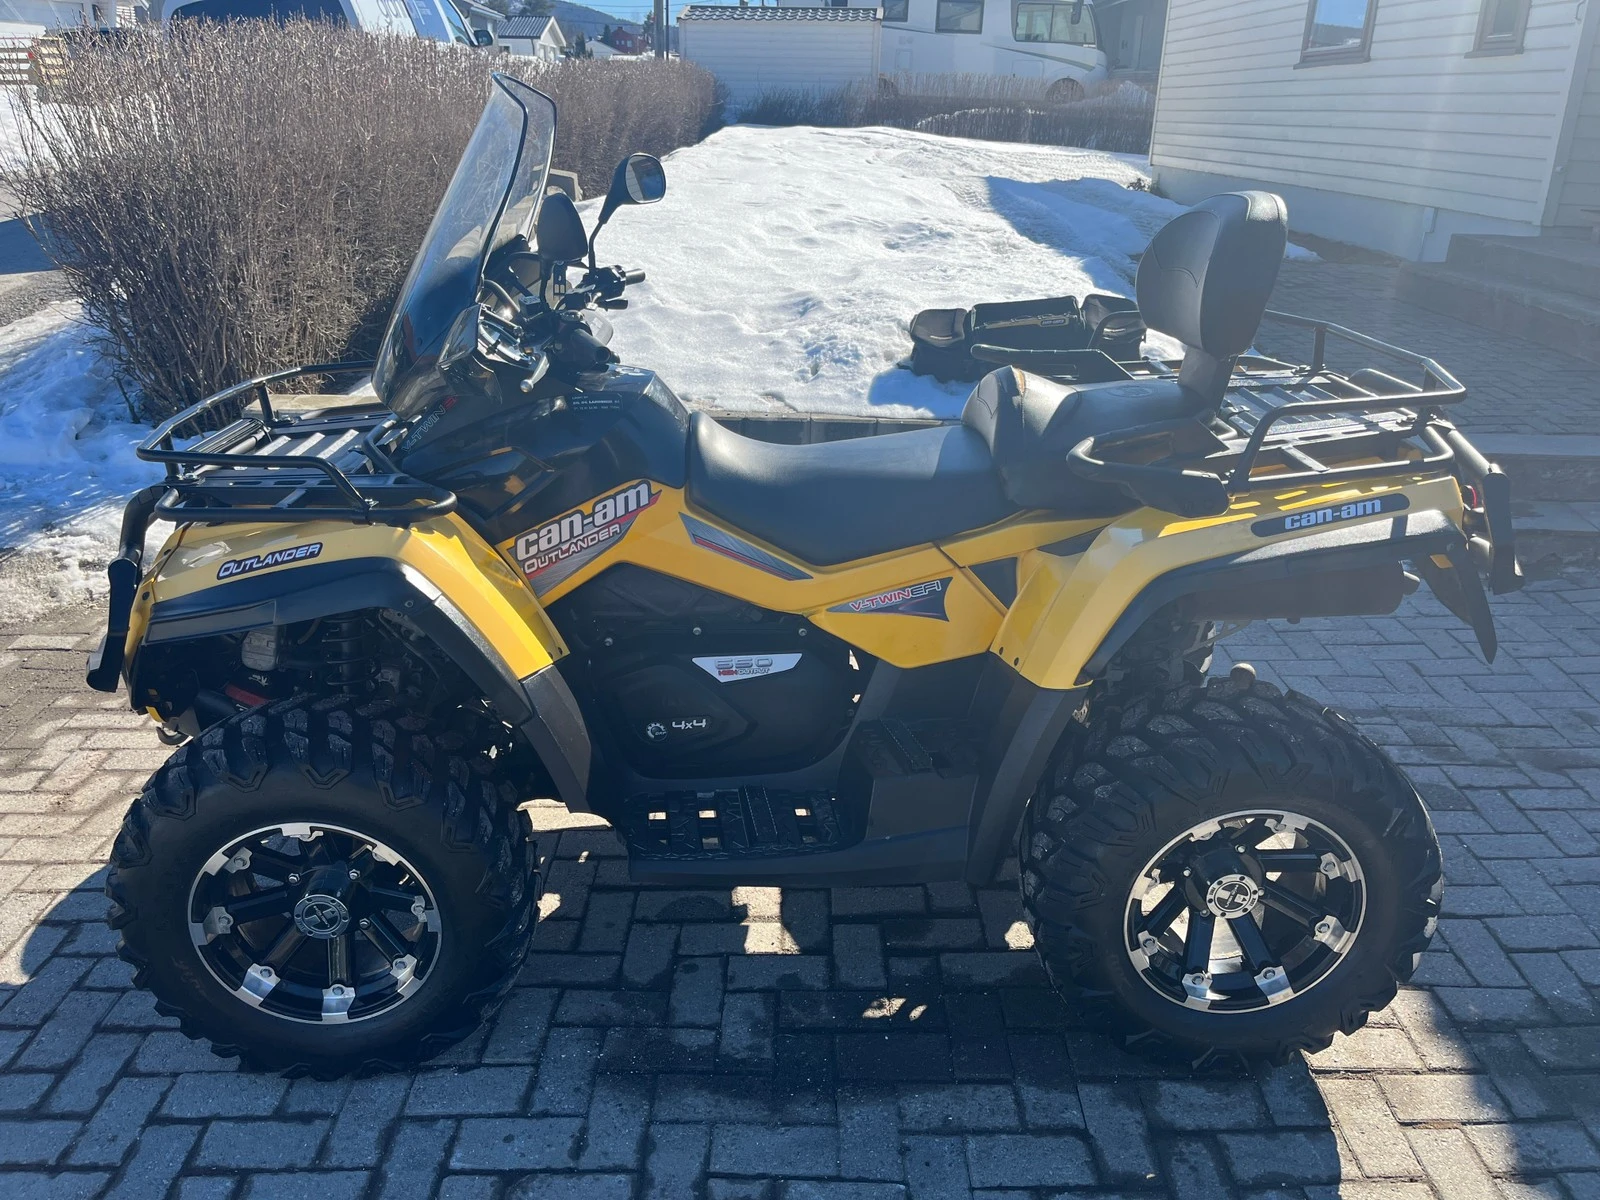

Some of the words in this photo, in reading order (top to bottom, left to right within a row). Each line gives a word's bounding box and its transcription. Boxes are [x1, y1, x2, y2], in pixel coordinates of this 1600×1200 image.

[516, 483, 649, 561] can-am
[1284, 499, 1381, 530] can-am
[218, 543, 321, 578] OUTLANDER
[524, 524, 620, 574] OUTLANDER
[715, 657, 773, 669] 650
[672, 719, 706, 729] 4x4
